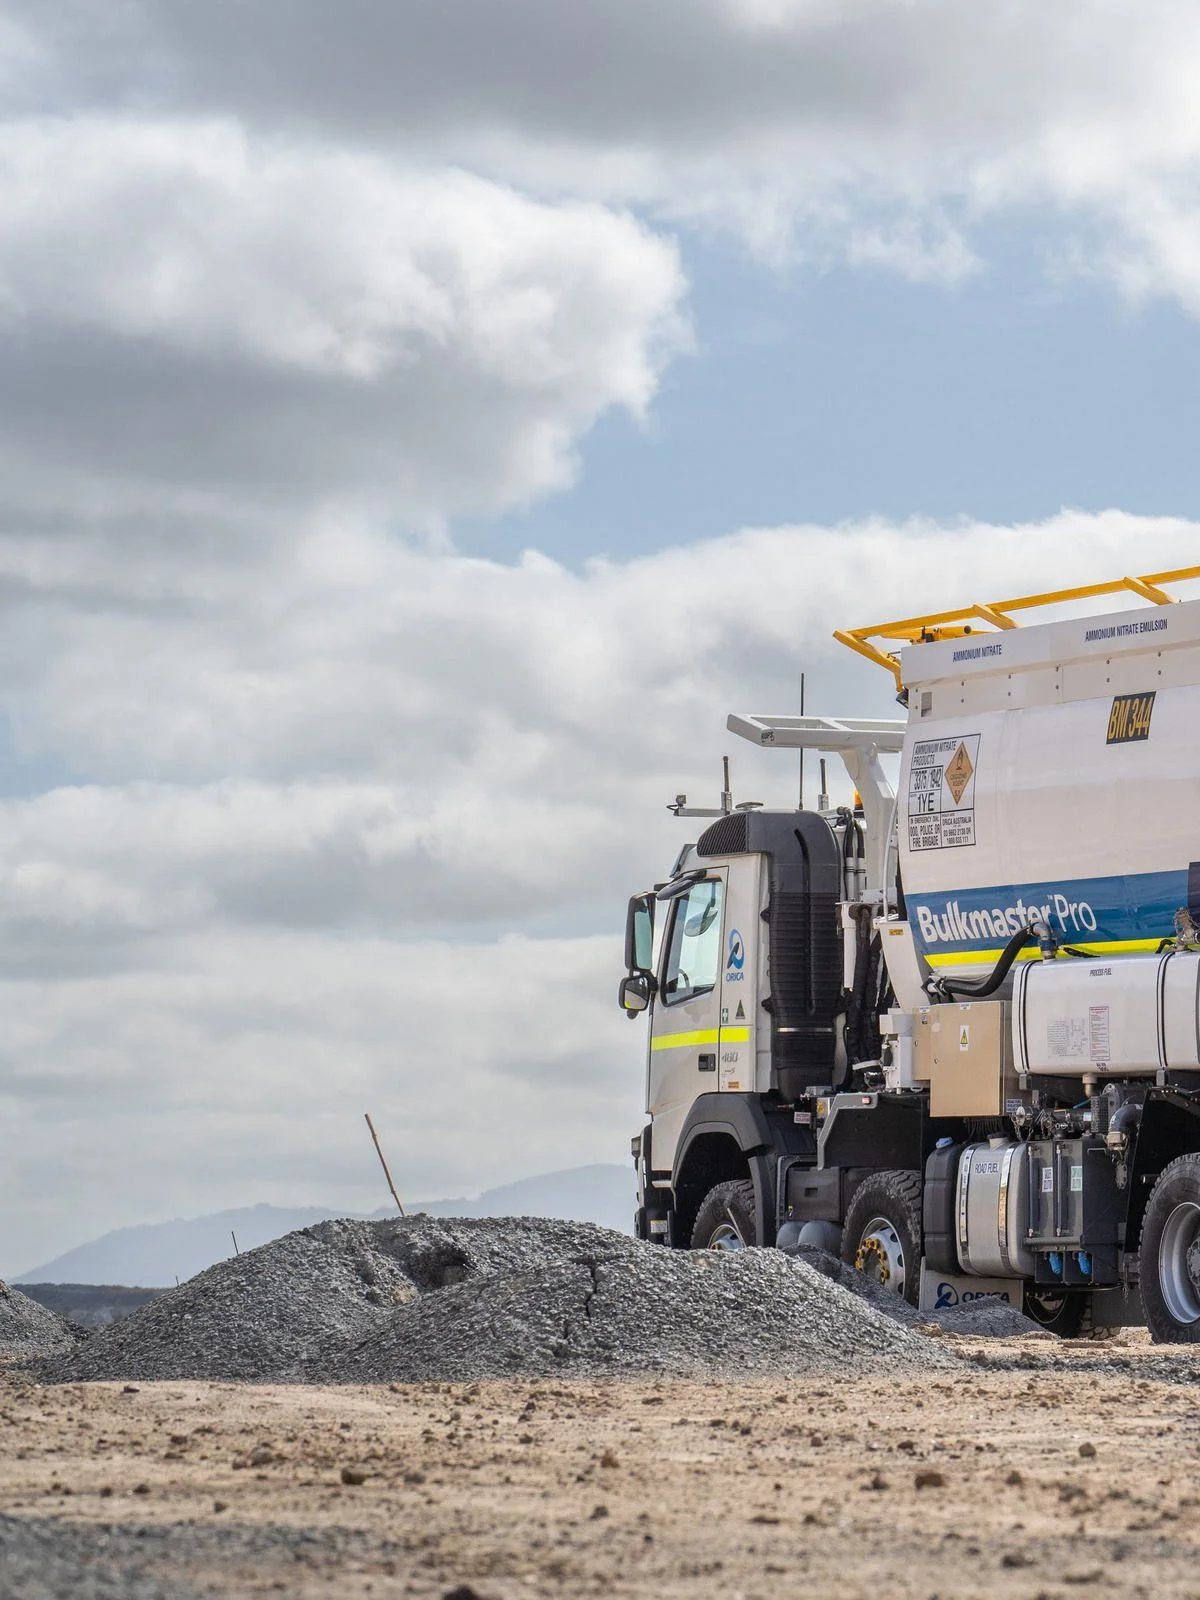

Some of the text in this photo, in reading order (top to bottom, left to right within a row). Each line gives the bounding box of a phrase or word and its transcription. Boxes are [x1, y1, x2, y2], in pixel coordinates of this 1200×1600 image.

[1085, 619, 1168, 642] AMMONIUM NITRATE EMULSION
[952, 644, 1002, 663] AMMONIUM NITRATE
[1108, 696, 1153, 740] BM 344
[914, 740, 957, 755] AMMONIUM NITRATE
[913, 754, 935, 766] PRODUCTS
[918, 792, 935, 813] 1YE
[1054, 894, 1097, 932] Pro
[725, 972, 744, 982] ORICA
[974, 1163, 999, 1174] ROAD FUEL
